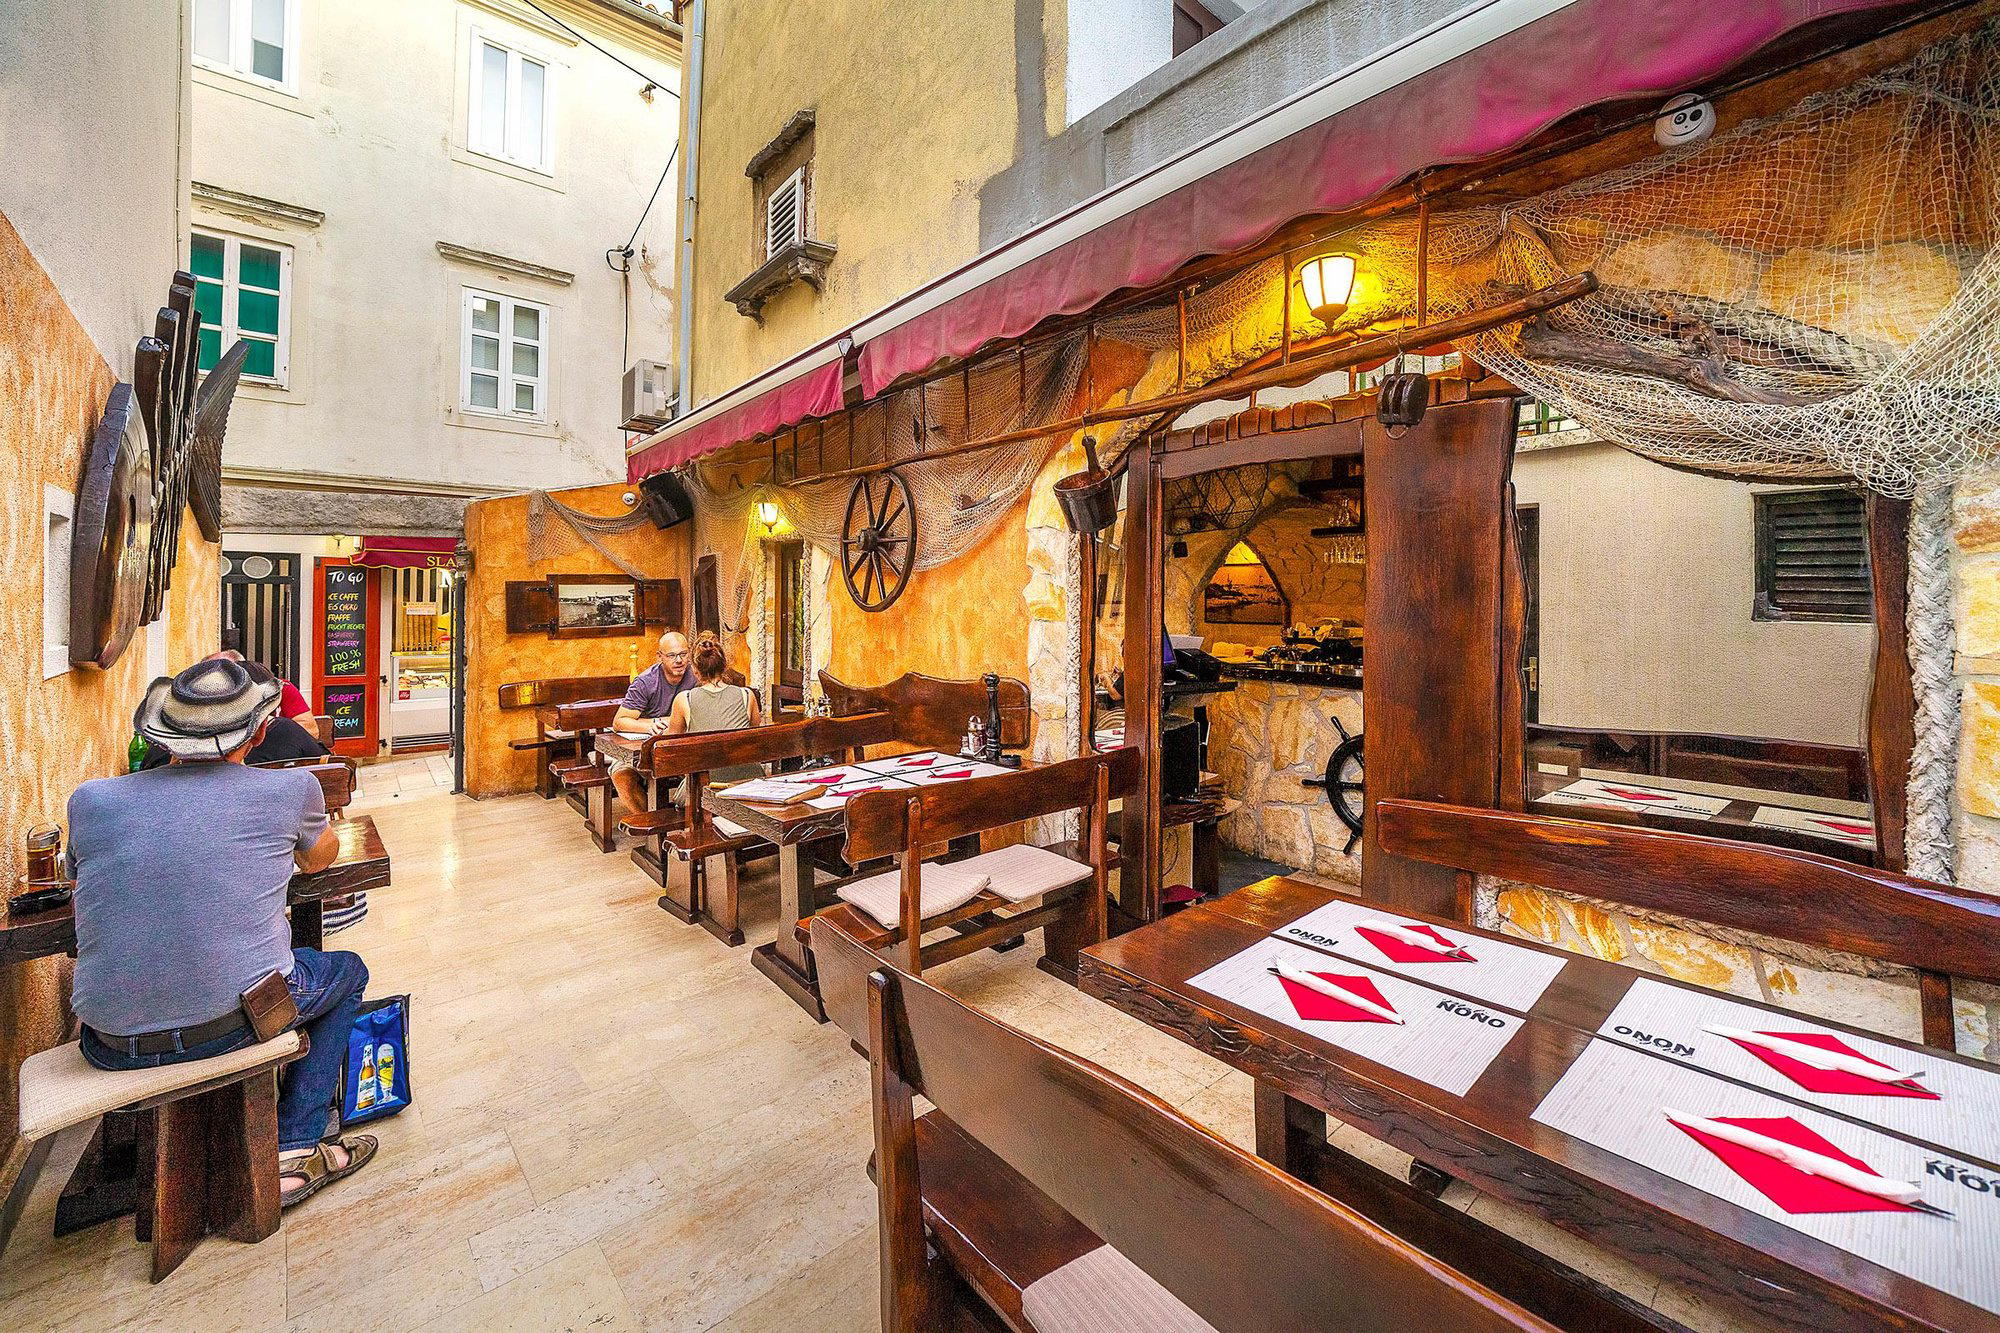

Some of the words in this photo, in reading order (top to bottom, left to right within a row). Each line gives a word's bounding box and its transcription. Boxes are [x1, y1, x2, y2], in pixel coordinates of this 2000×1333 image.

[328, 571, 345, 584] TO
[347, 572, 364, 585] GO
[330, 651, 349, 663] 100
[331, 659, 361, 675] FRESH
[326, 692, 364, 704] SORBET
[334, 717, 360, 729] REAM
[1436, 1000, 1506, 1028] NONO
[1925, 1160, 2000, 1199] NO
